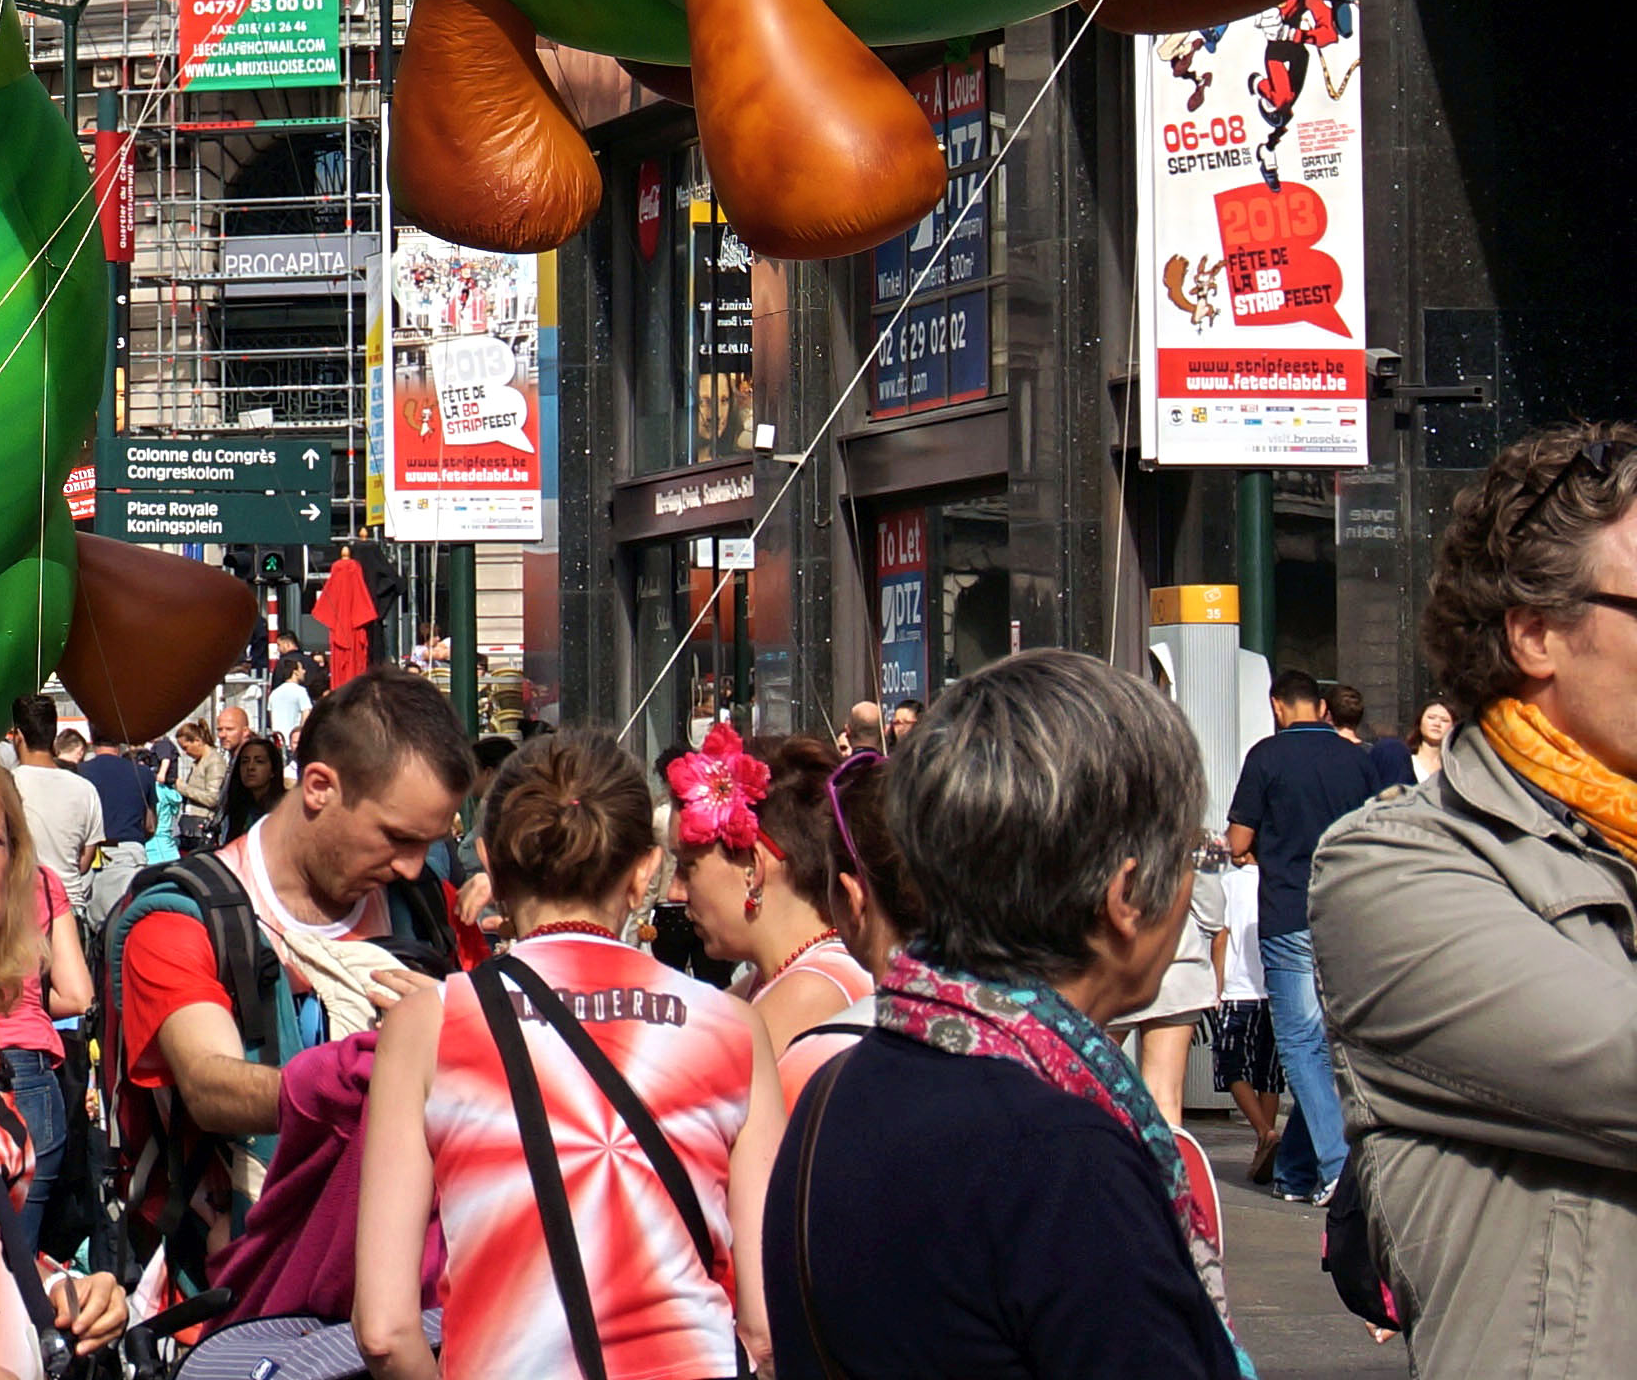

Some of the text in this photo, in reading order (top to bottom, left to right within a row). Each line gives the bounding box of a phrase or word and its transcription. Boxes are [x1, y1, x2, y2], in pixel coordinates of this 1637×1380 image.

[193, 0, 245, 15] 0479/
[263, 22, 276, 33] 61
[279, 21, 292, 33] 26
[294, 21, 307, 32] 46
[184, 58, 336, 78] WWW.LA-BRUXELLOISE.COM
[947, 70, 982, 111] Louer
[1164, 115, 1246, 153] 06-08
[1167, 148, 1242, 175] SEPTEMB
[1302, 152, 1342, 168] GRATUIT
[1304, 166, 1339, 181] GRATIS
[1222, 192, 1318, 245] 2013
[1228, 246, 1288, 272] FÊTE DE
[878, 270, 902, 300] Winkel
[1231, 268, 1282, 293] LA BD
[1234, 284, 1332, 316] STRIPFEEST
[878, 330, 893, 367] 02
[930, 316, 946, 355] 02
[950, 311, 966, 351] 02
[437, 345, 506, 384] 2013
[1189, 357, 1344, 377] www.stripfeest.be
[1186, 373, 1347, 391] www.fetedelabd.be
[441, 384, 485, 403] FÊTE DE
[444, 405, 460, 420] LA
[447, 412, 517, 435] STRIPFEEST
[127, 447, 276, 465] Colonne du Congrès
[127, 465, 234, 482] Congreskolom
[405, 468, 529, 482] www.fetedelabd.be
[127, 501, 218, 518] Place Royale
[127, 519, 223, 535] Koningsplein
[878, 517, 921, 567] To Let
[896, 581, 922, 626] DTZ
[1206, 608, 1221, 619] 35
[882, 661, 900, 694] 300
